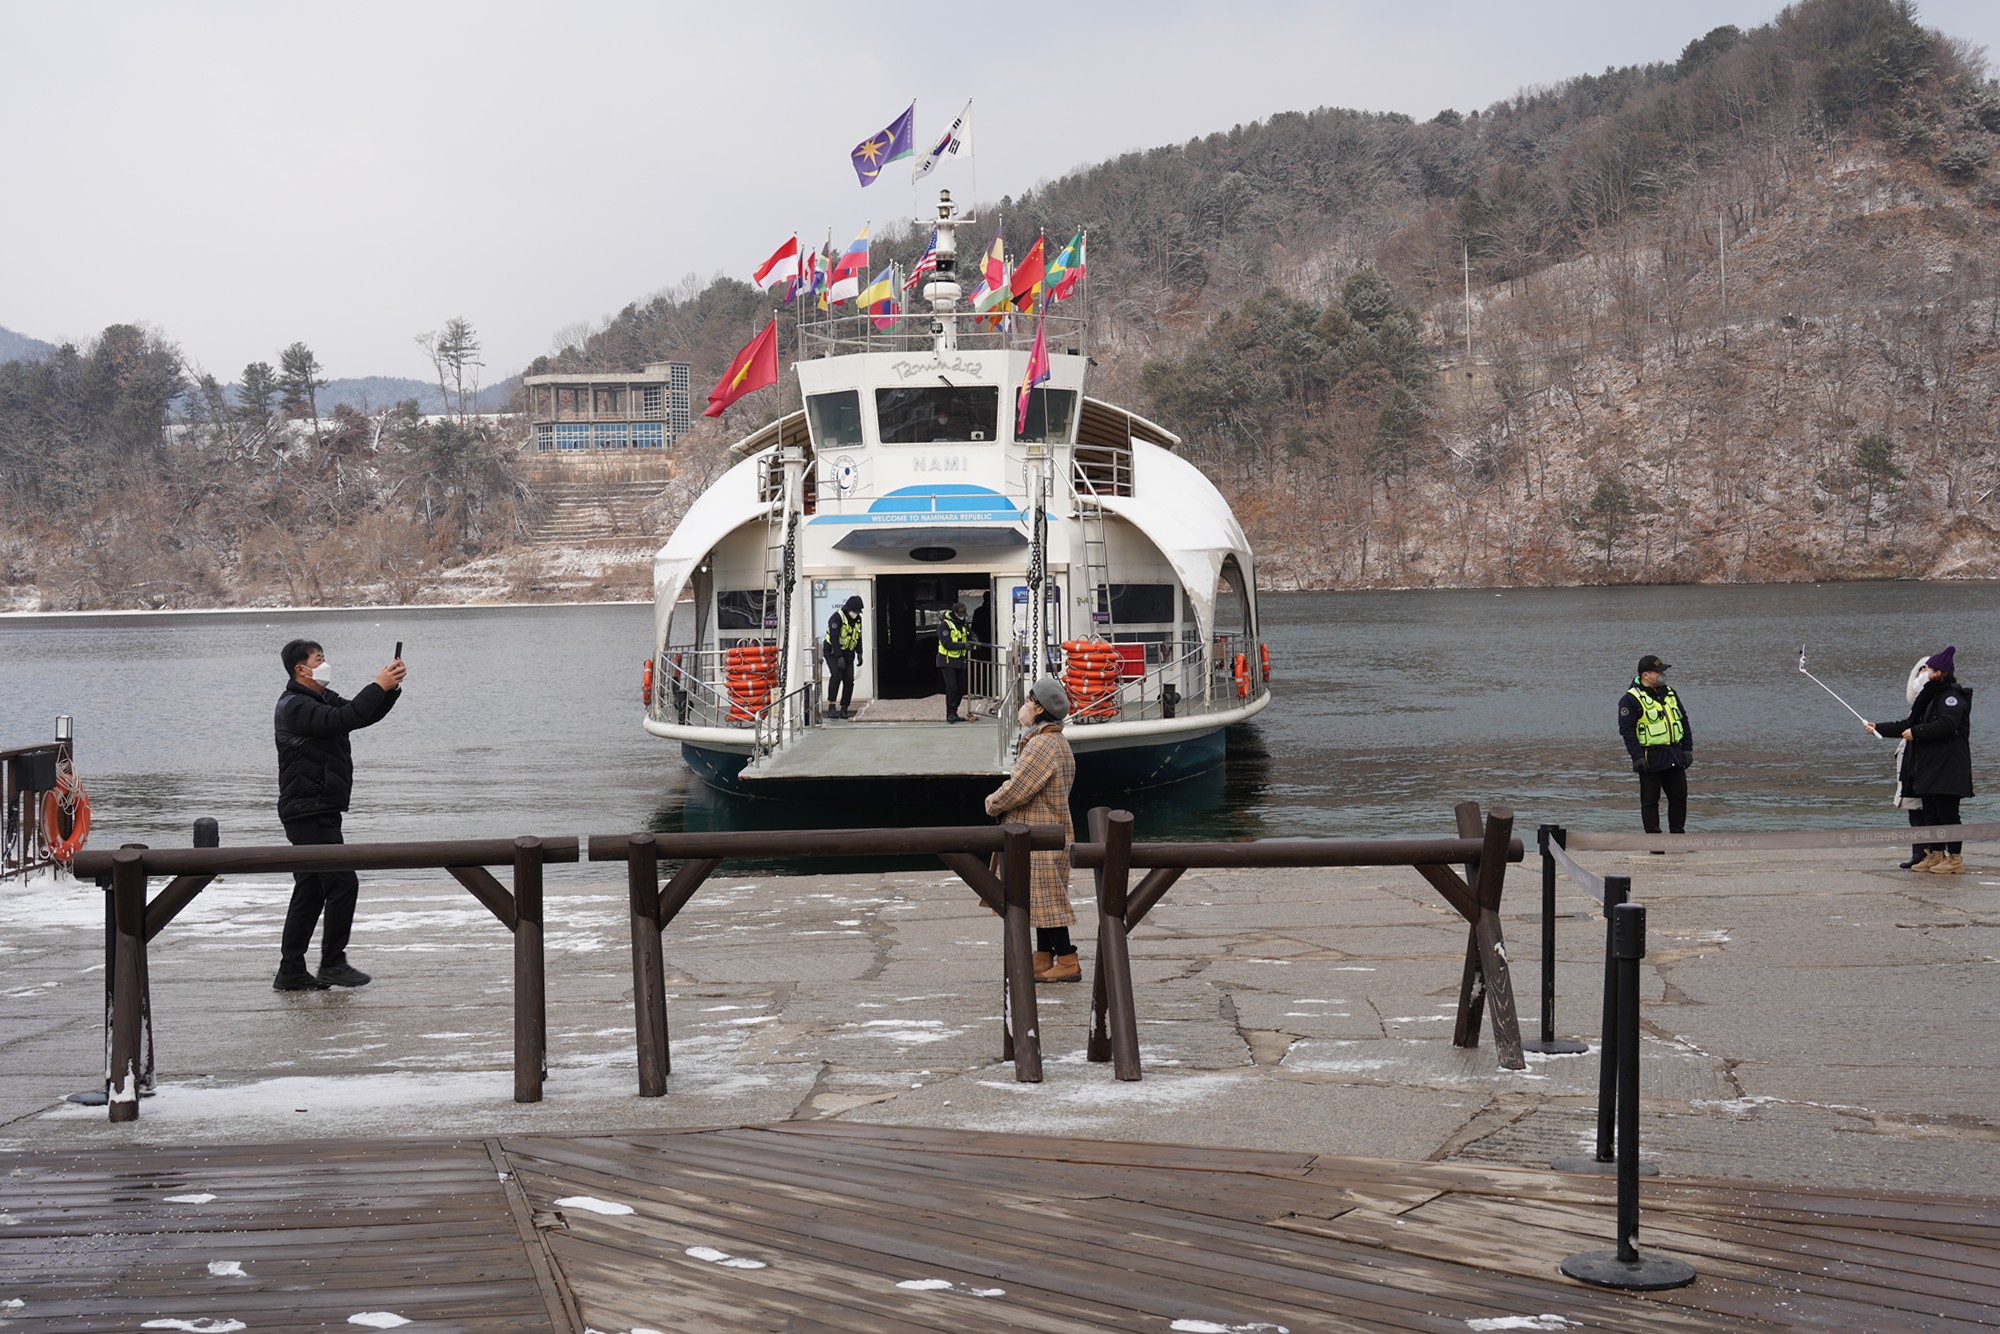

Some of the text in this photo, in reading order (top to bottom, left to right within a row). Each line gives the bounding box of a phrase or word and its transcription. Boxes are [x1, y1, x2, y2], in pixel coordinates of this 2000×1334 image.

[912, 455, 968, 472] NAMI
[1661, 838, 1742, 847] NAMINARA REPUBLIC
